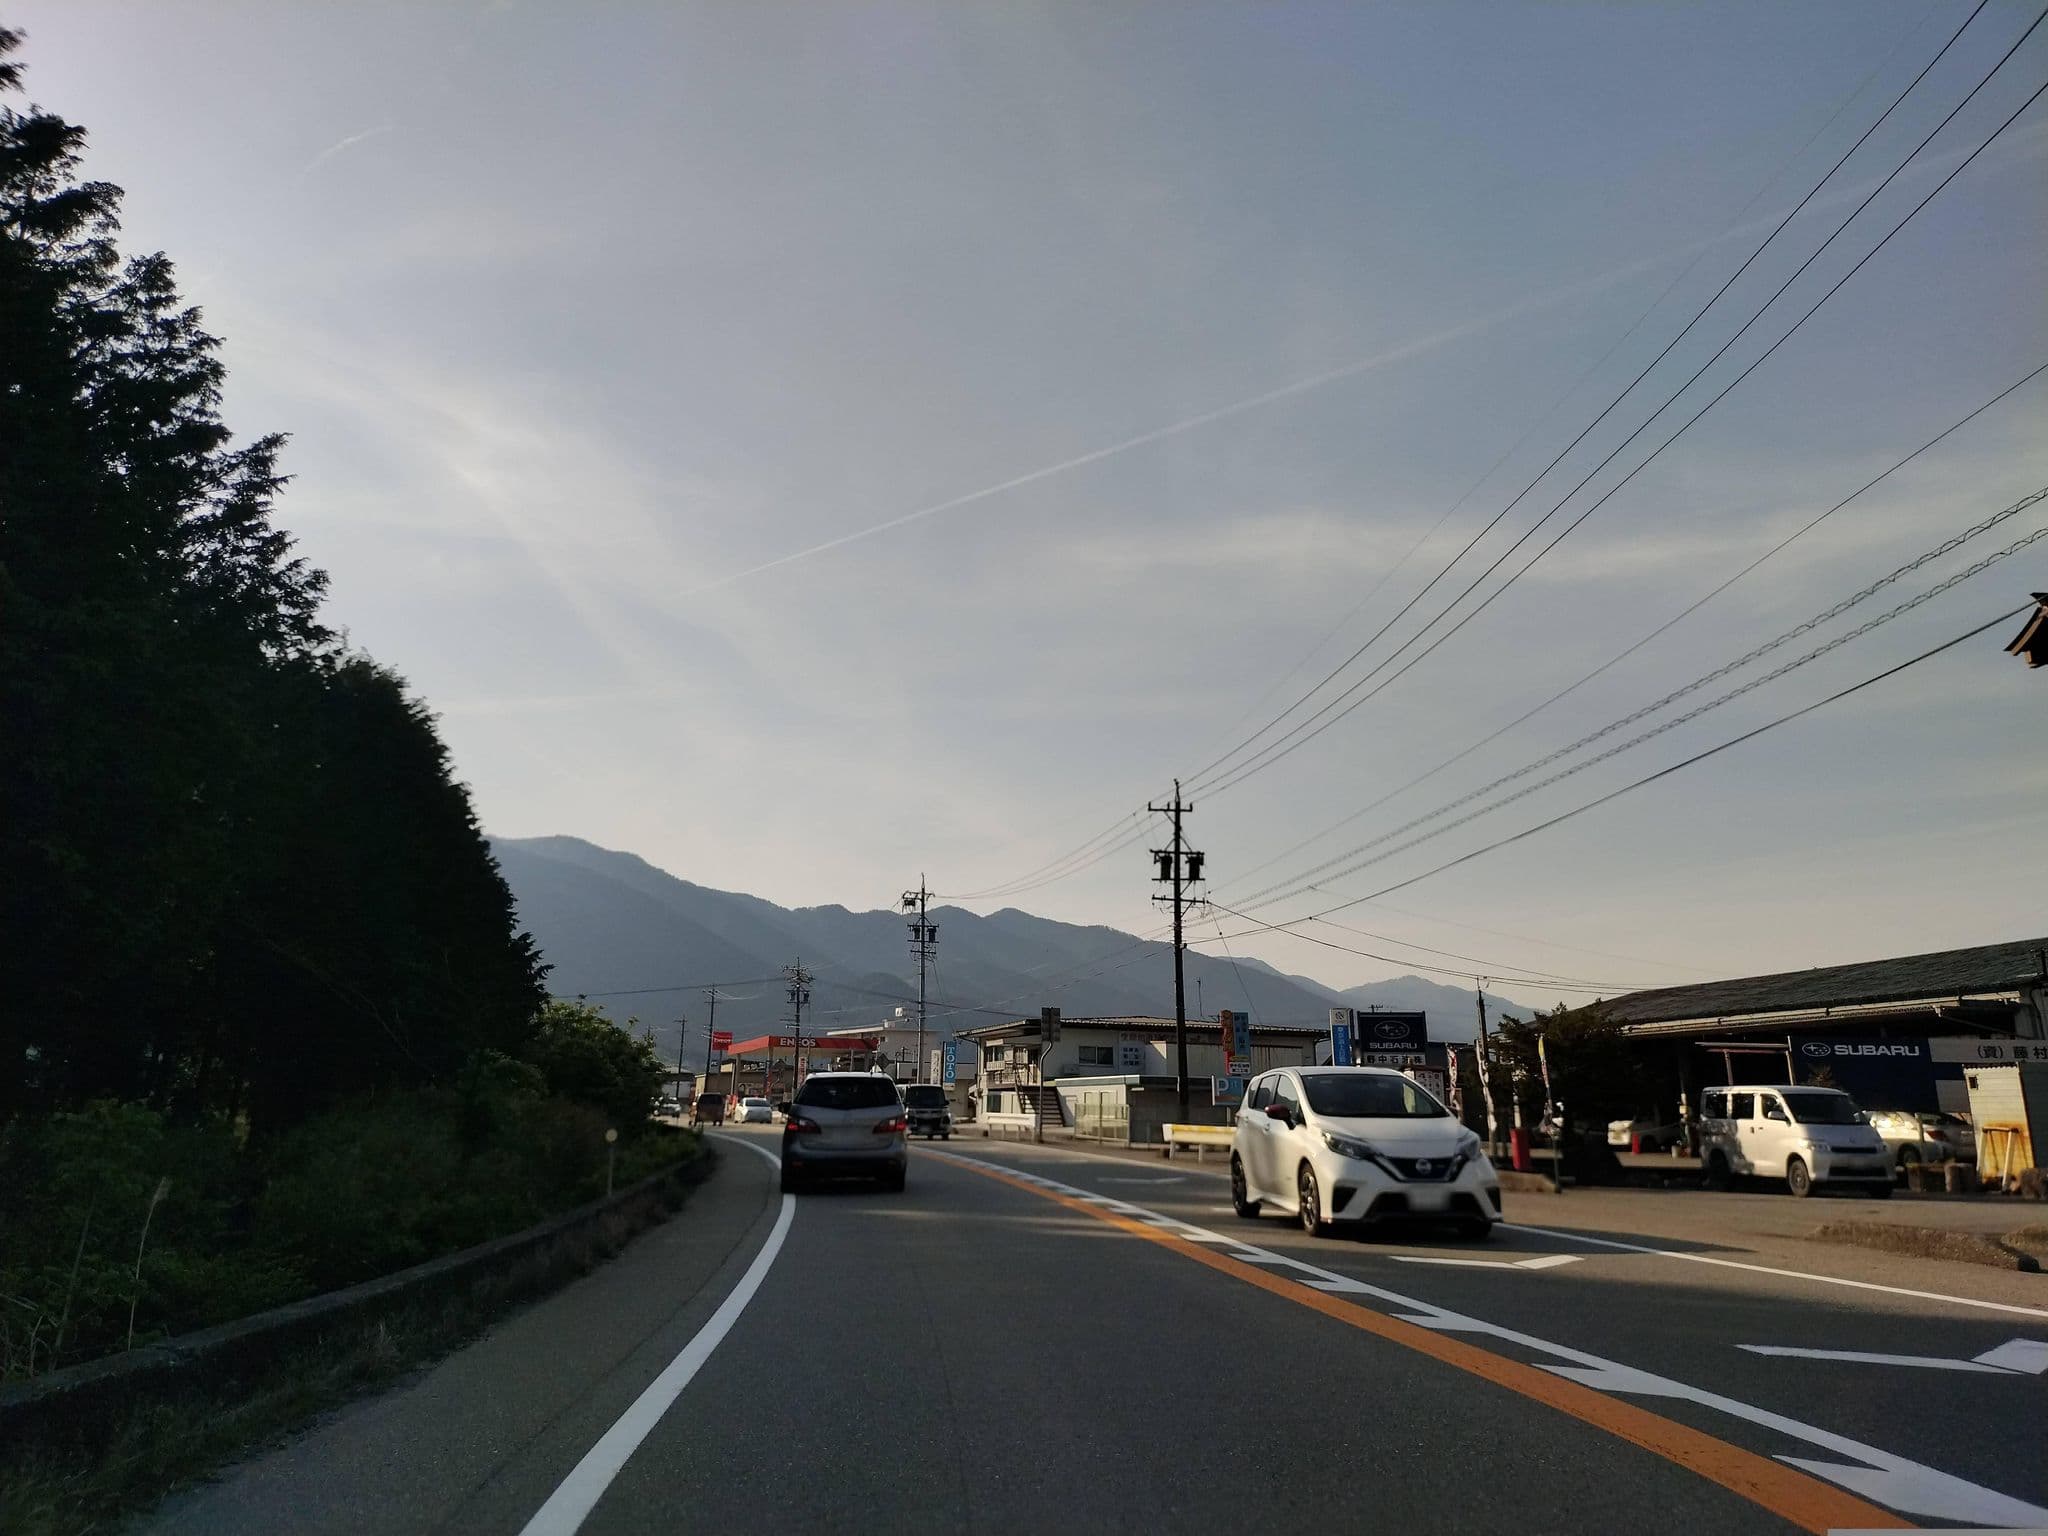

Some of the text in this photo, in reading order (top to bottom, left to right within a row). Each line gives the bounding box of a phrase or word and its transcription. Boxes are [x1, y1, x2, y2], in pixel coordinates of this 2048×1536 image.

[1369, 1041, 1418, 1050] SUBARU
[1834, 1044, 1919, 1057] SUBARU
[946, 1046, 956, 1079] TOTO
[1216, 1078, 1229, 1097] P
